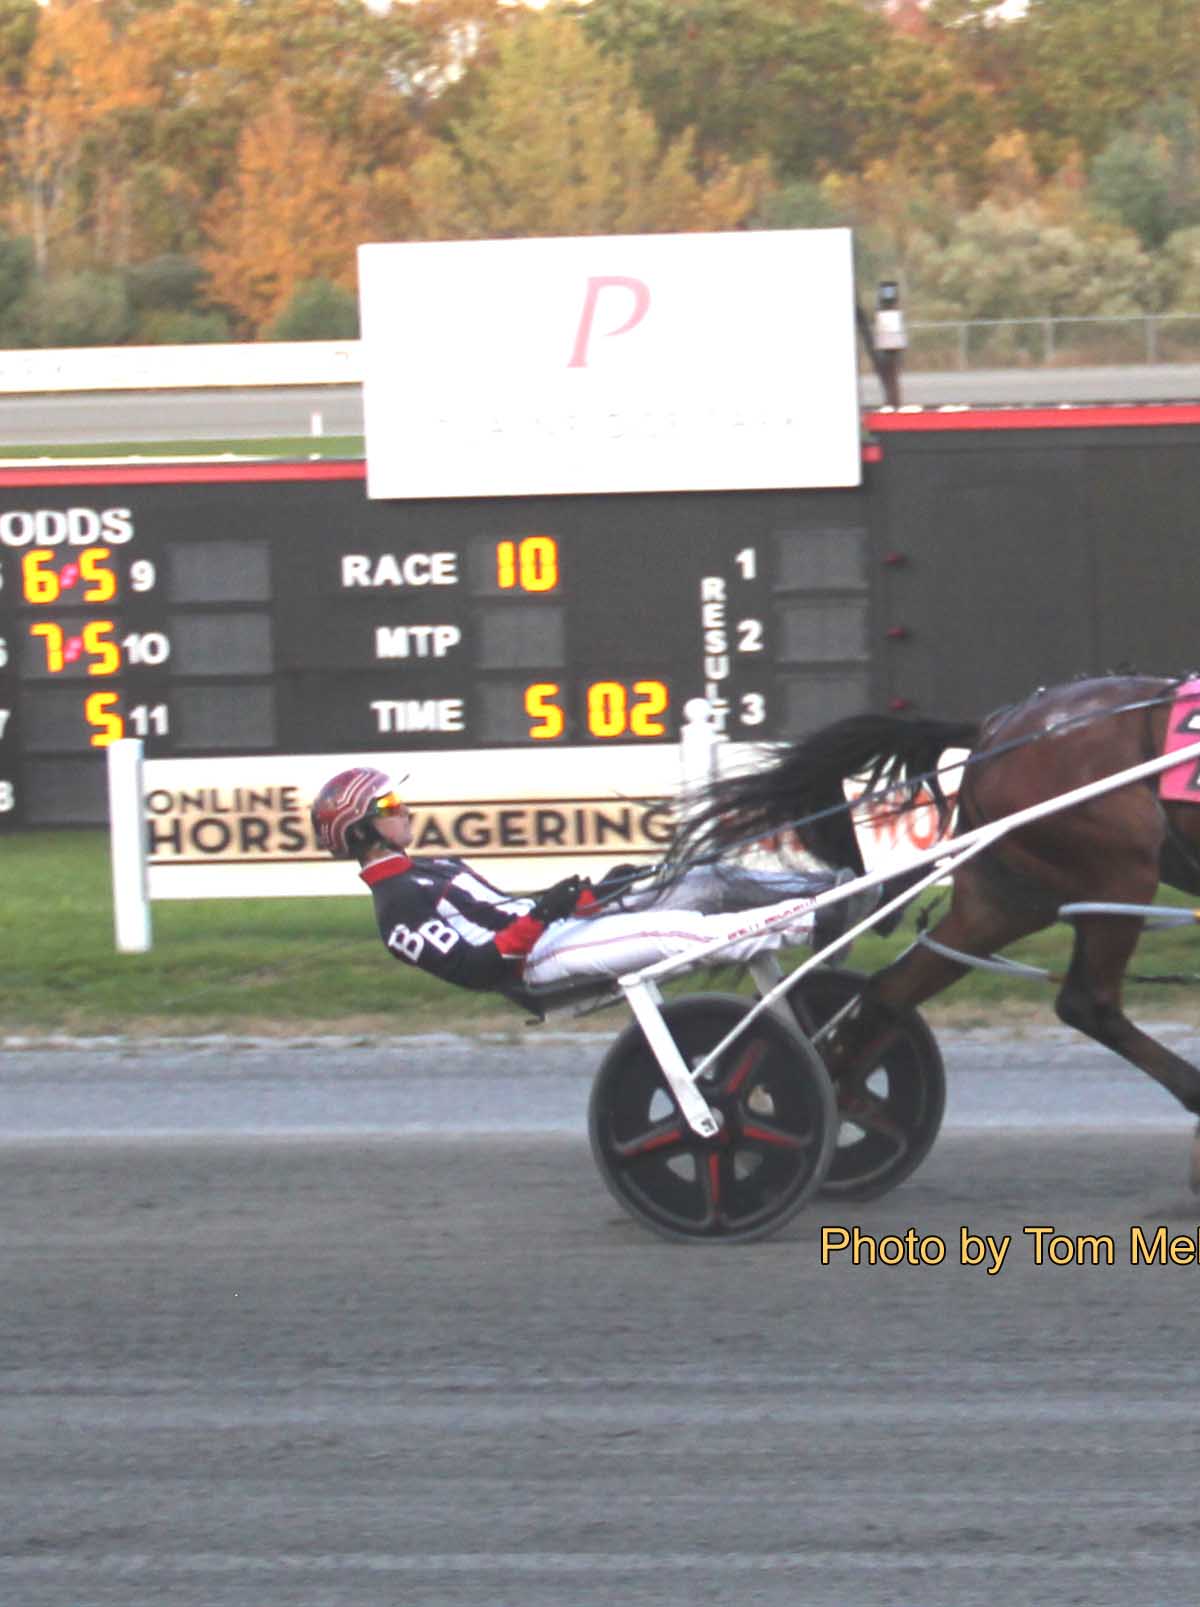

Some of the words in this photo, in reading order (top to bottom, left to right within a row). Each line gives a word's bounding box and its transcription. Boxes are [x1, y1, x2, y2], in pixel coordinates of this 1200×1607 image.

[566, 274, 652, 369] P
[0, 508, 134, 546] ODDS
[130, 560, 156, 592] 9
[341, 552, 459, 588] RACE
[496, 536, 559, 593] 10
[736, 548, 757, 580] 1
[122, 633, 170, 665] 10
[375, 626, 461, 659] MTP
[737, 619, 764, 652] 2
[84, 691, 125, 747] 5
[129, 704, 169, 736] 11
[370, 699, 466, 732] TIME
[524, 683, 564, 739] 5
[587, 681, 669, 738] 02
[740, 693, 766, 726] 3
[148, 786, 300, 817] ONLINE
[149, 816, 308, 854] HORS
[408, 806, 675, 848] AGERING
